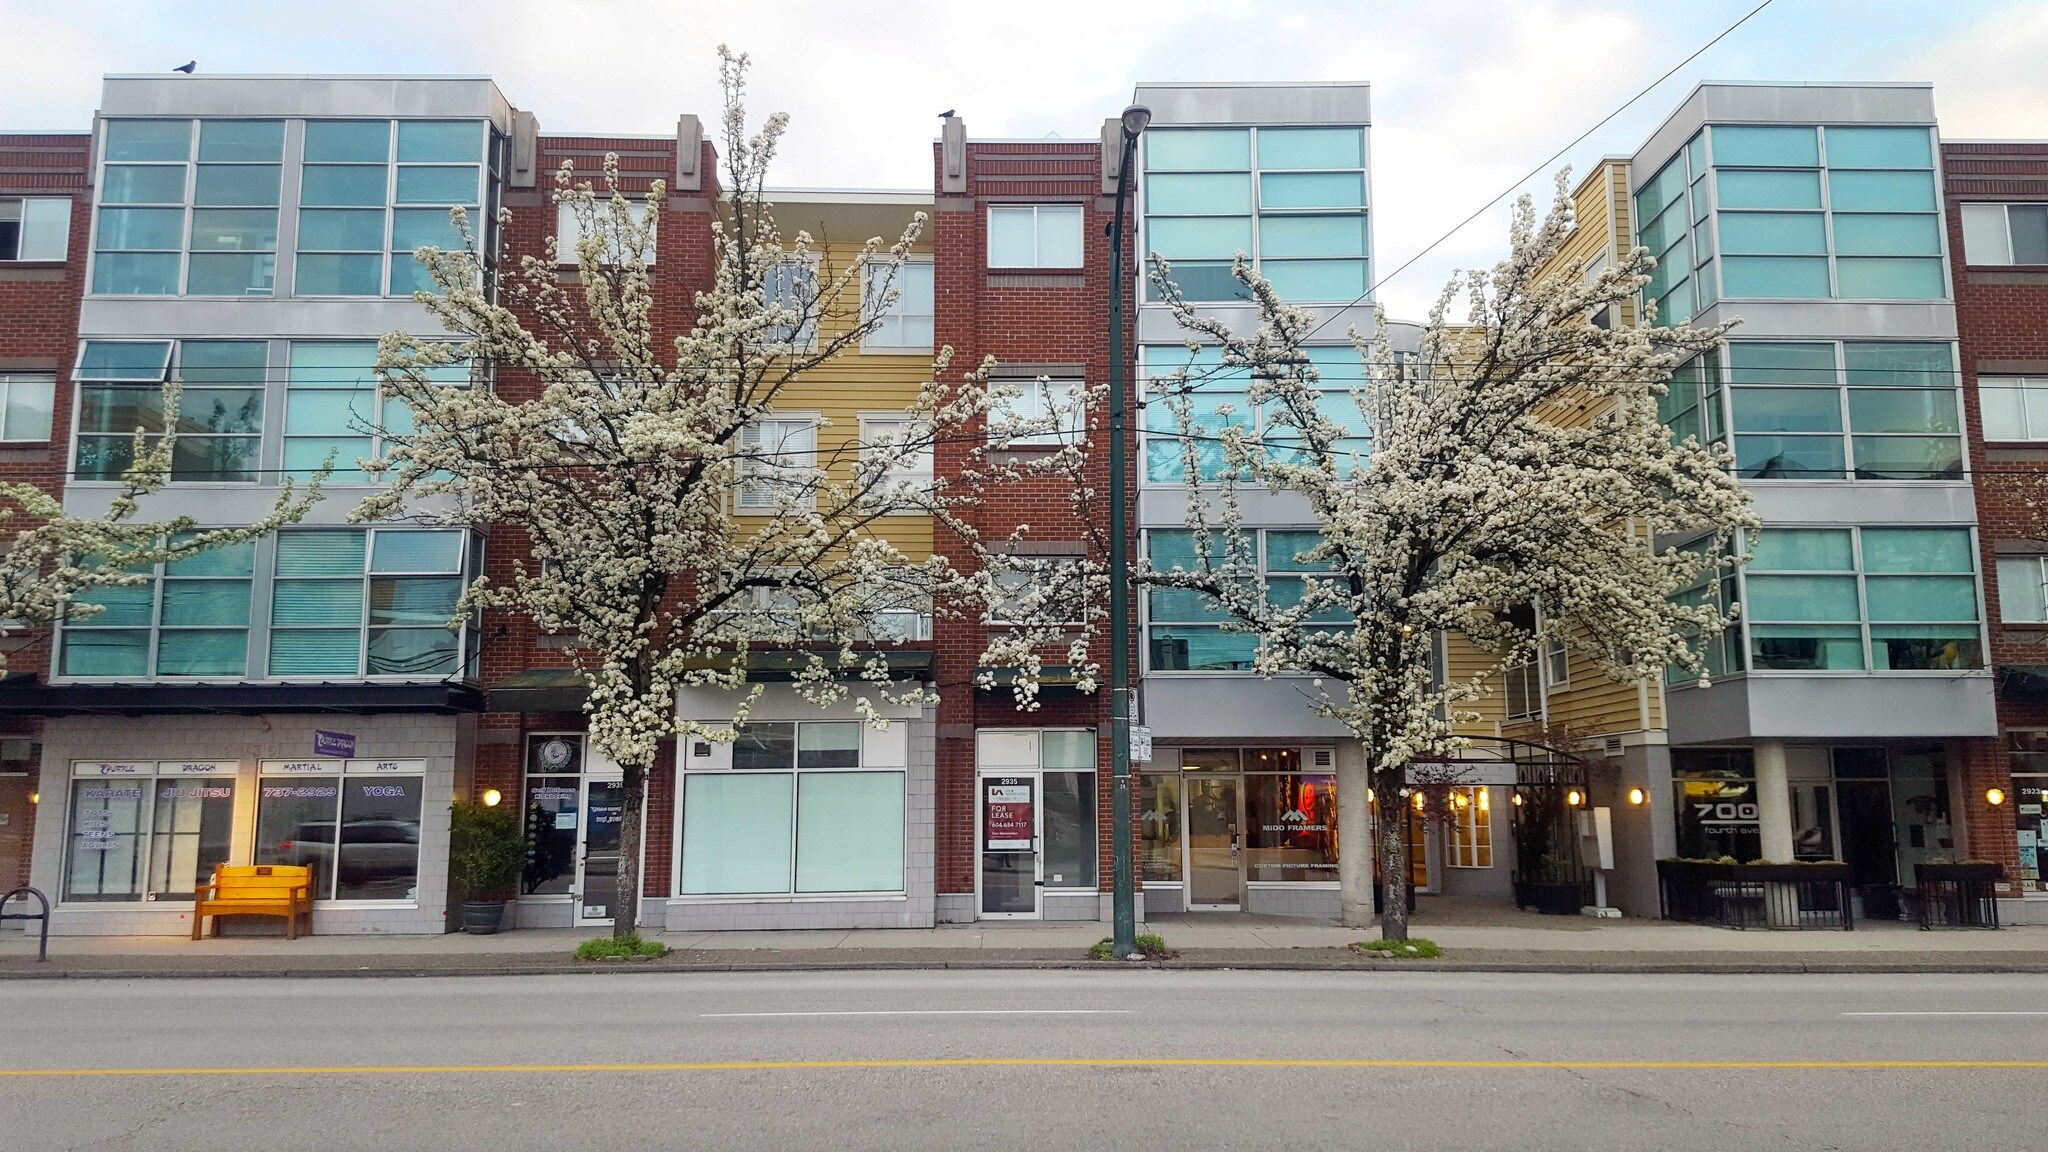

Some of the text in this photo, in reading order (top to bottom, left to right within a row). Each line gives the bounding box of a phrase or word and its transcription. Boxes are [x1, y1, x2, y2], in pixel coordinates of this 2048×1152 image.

[182, 764, 216, 772] DRAGON
[282, 764, 322, 772] MARTIAL
[376, 762, 398, 770] ARTS
[85, 788, 142, 798] KARATE
[162, 787, 231, 798] JIU JITSU
[264, 787, 338, 797] 737-2929
[363, 786, 405, 796] YOGA
[1693, 803, 1759, 819] 700
